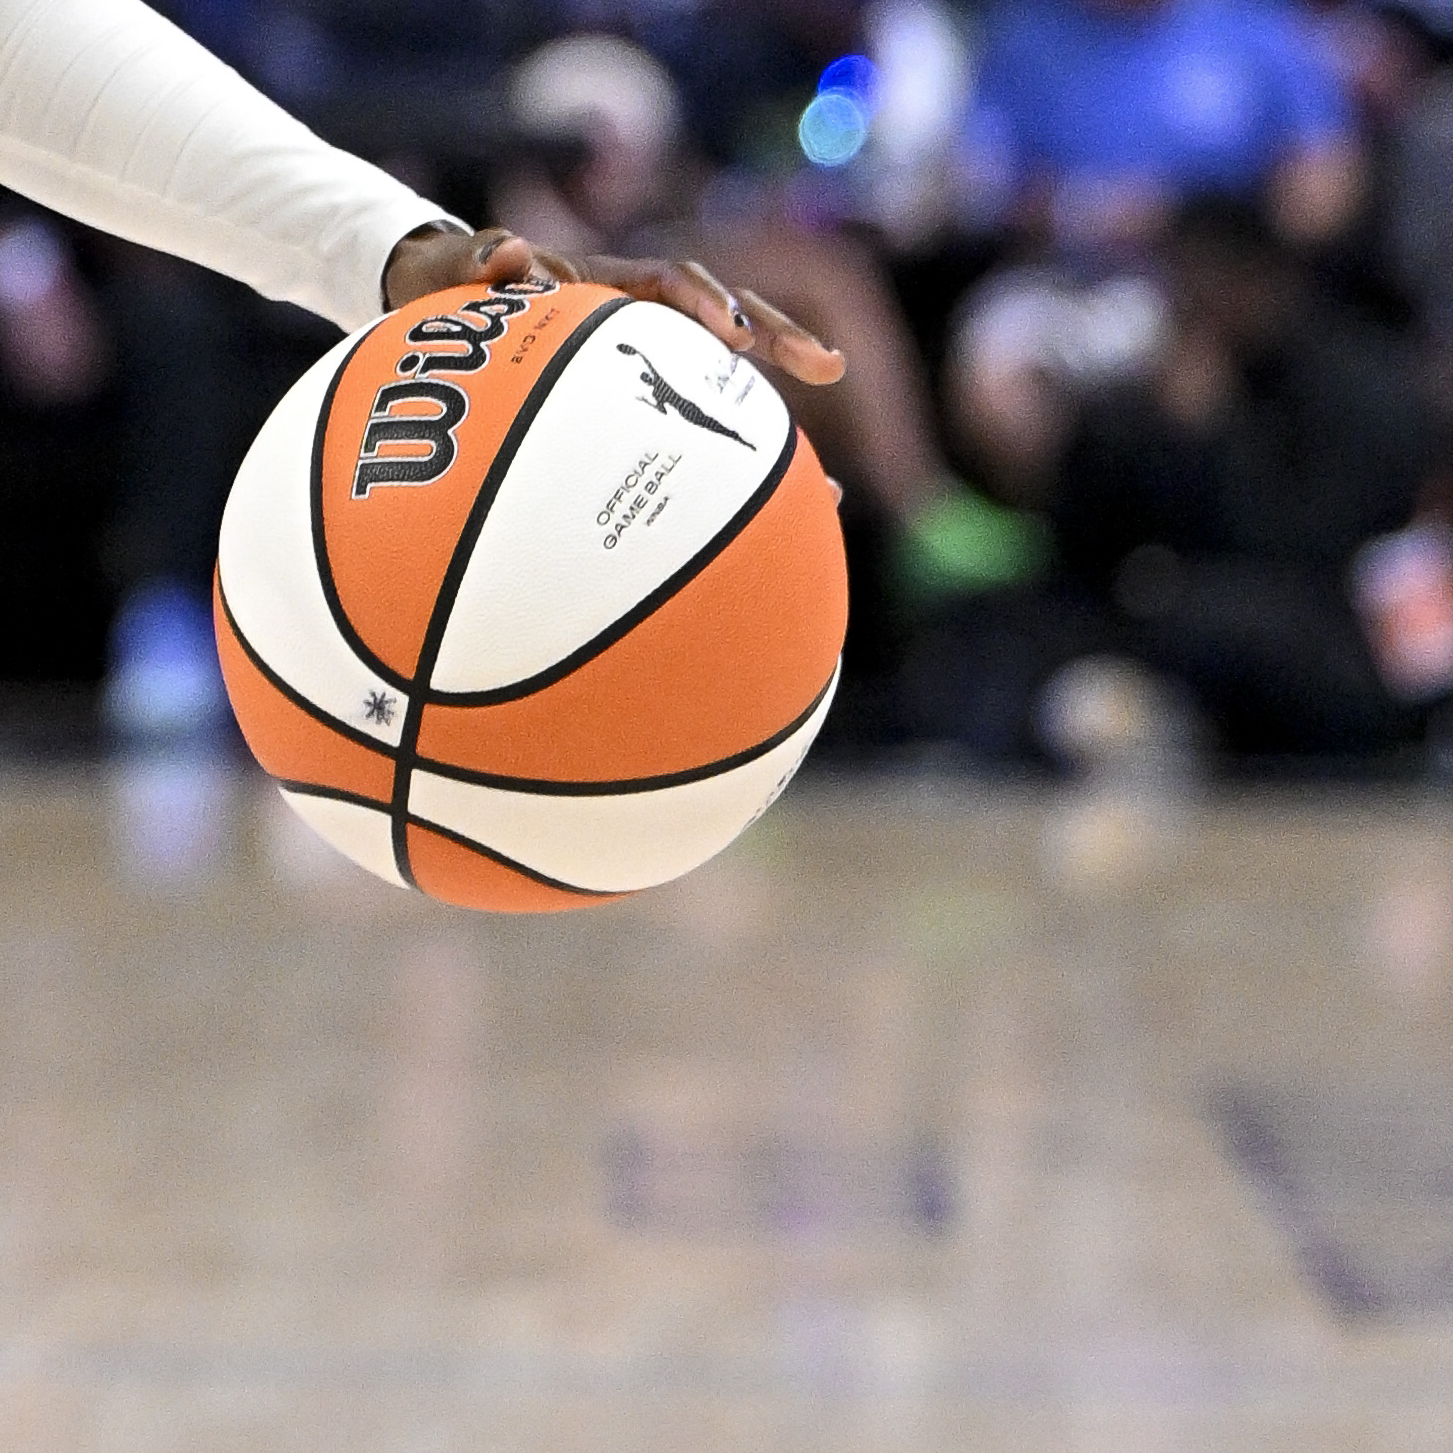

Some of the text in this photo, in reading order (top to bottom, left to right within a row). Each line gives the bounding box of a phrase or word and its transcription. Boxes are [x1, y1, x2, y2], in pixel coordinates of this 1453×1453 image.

[596, 452, 659, 526] OFFICIAL
[603, 454, 683, 550] GAME BALL
